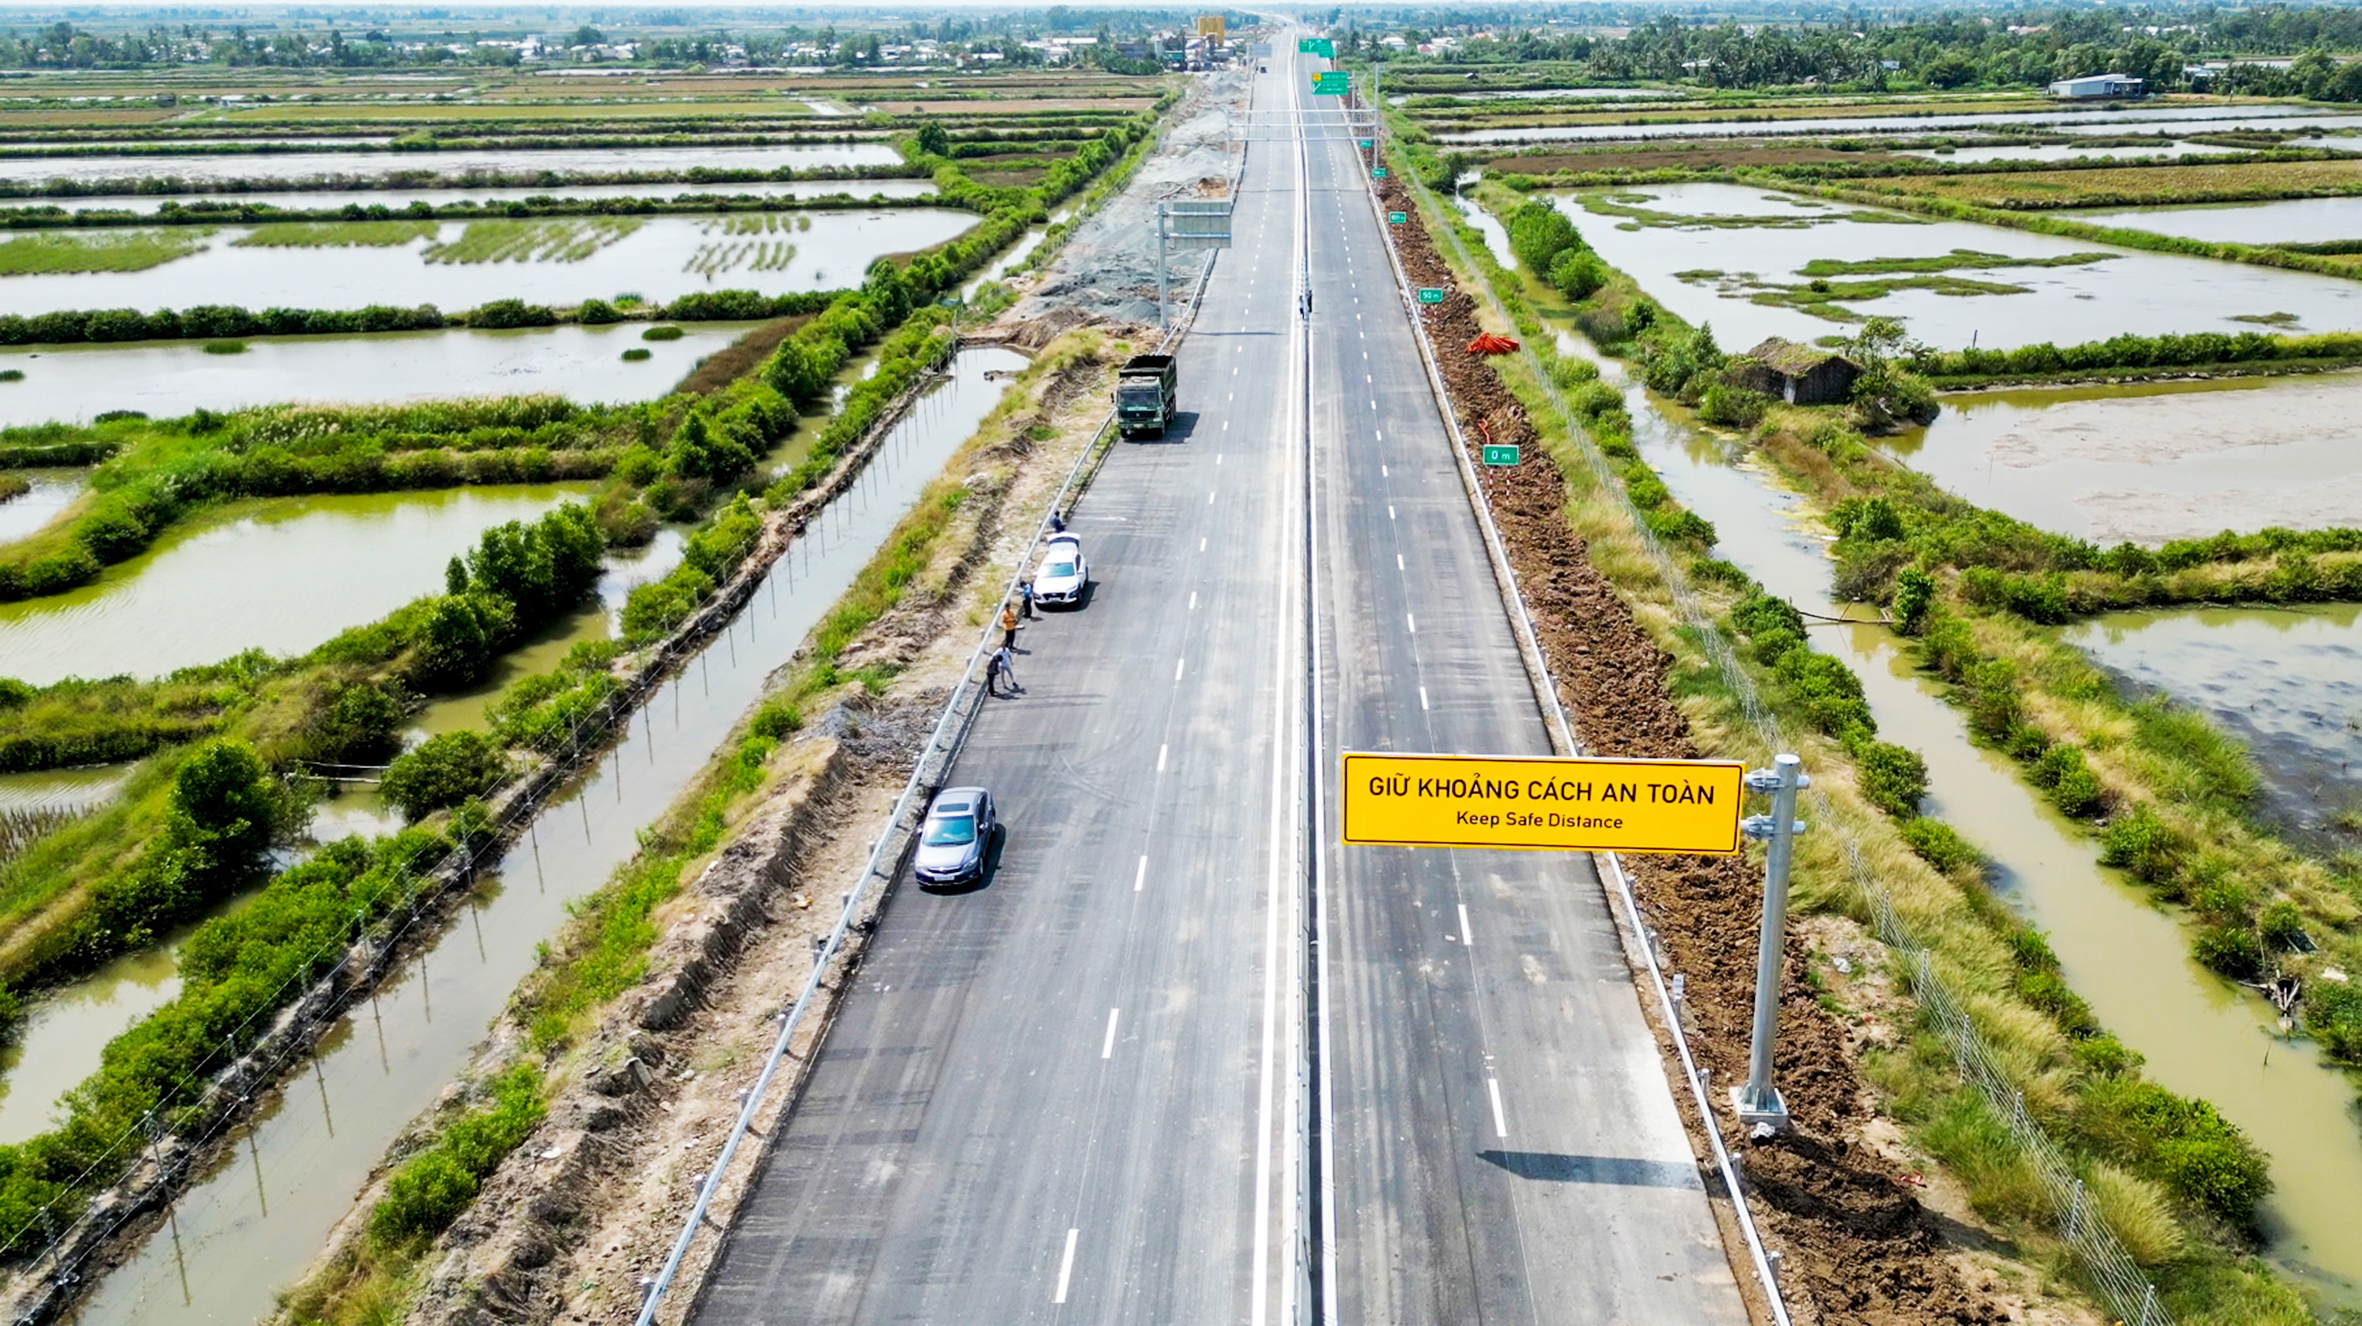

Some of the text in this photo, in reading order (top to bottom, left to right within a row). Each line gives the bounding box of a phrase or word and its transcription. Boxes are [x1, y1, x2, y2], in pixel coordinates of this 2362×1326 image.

[1491, 450, 1498, 460] 0
[1369, 771, 1715, 805] GIỮ KHOẢNG CÁCH AN TOÀN
[1457, 811, 1623, 829] Keep Safe Distance
